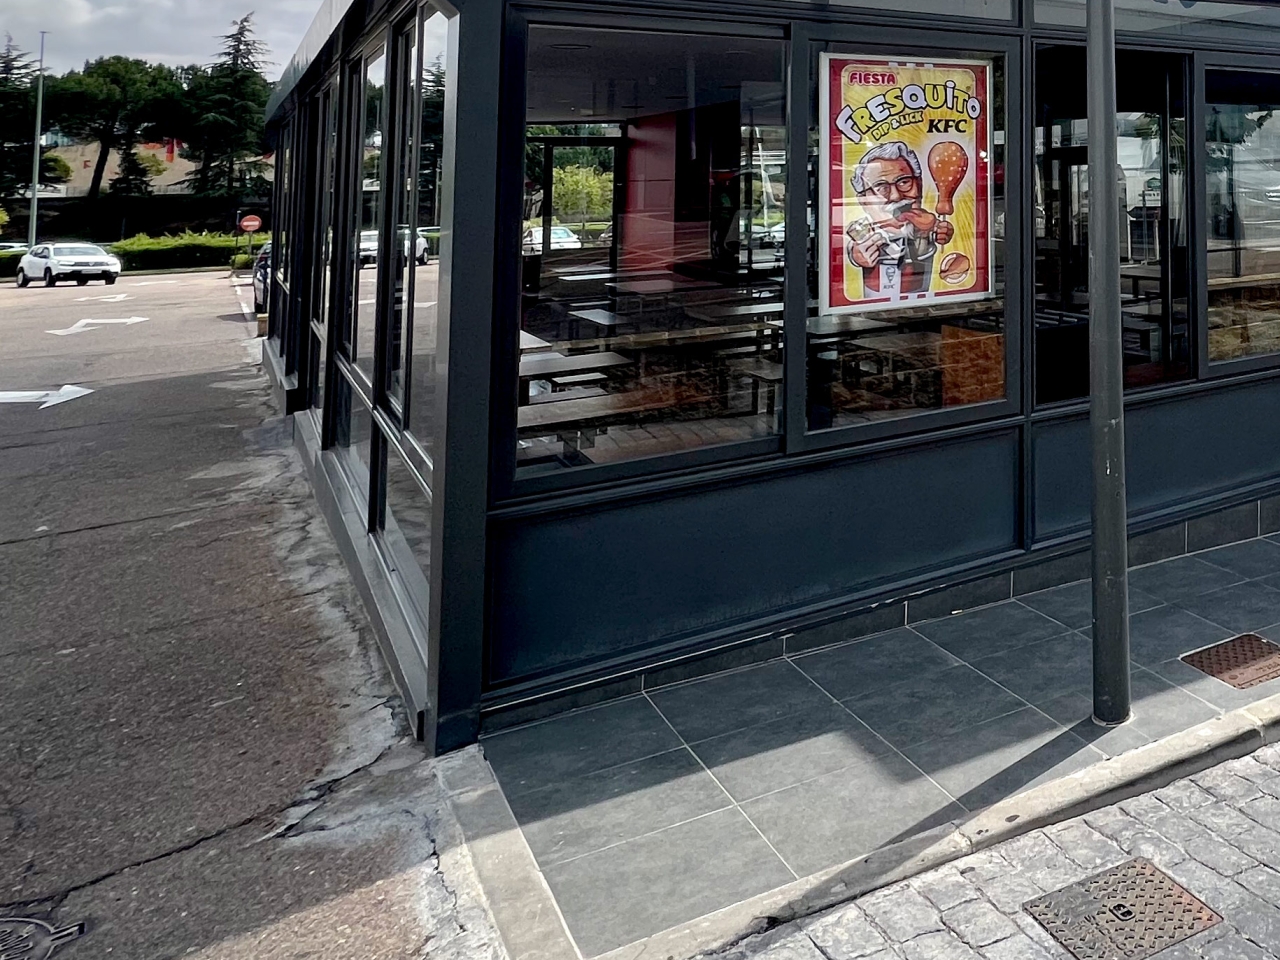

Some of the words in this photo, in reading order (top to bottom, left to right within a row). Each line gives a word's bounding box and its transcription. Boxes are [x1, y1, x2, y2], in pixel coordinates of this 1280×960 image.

[849, 71, 898, 85] FIESTA
[871, 122, 890, 141] DIP
[891, 118, 900, 130] &
[899, 110, 924, 127] LICK
[926, 119, 968, 134] KFC
